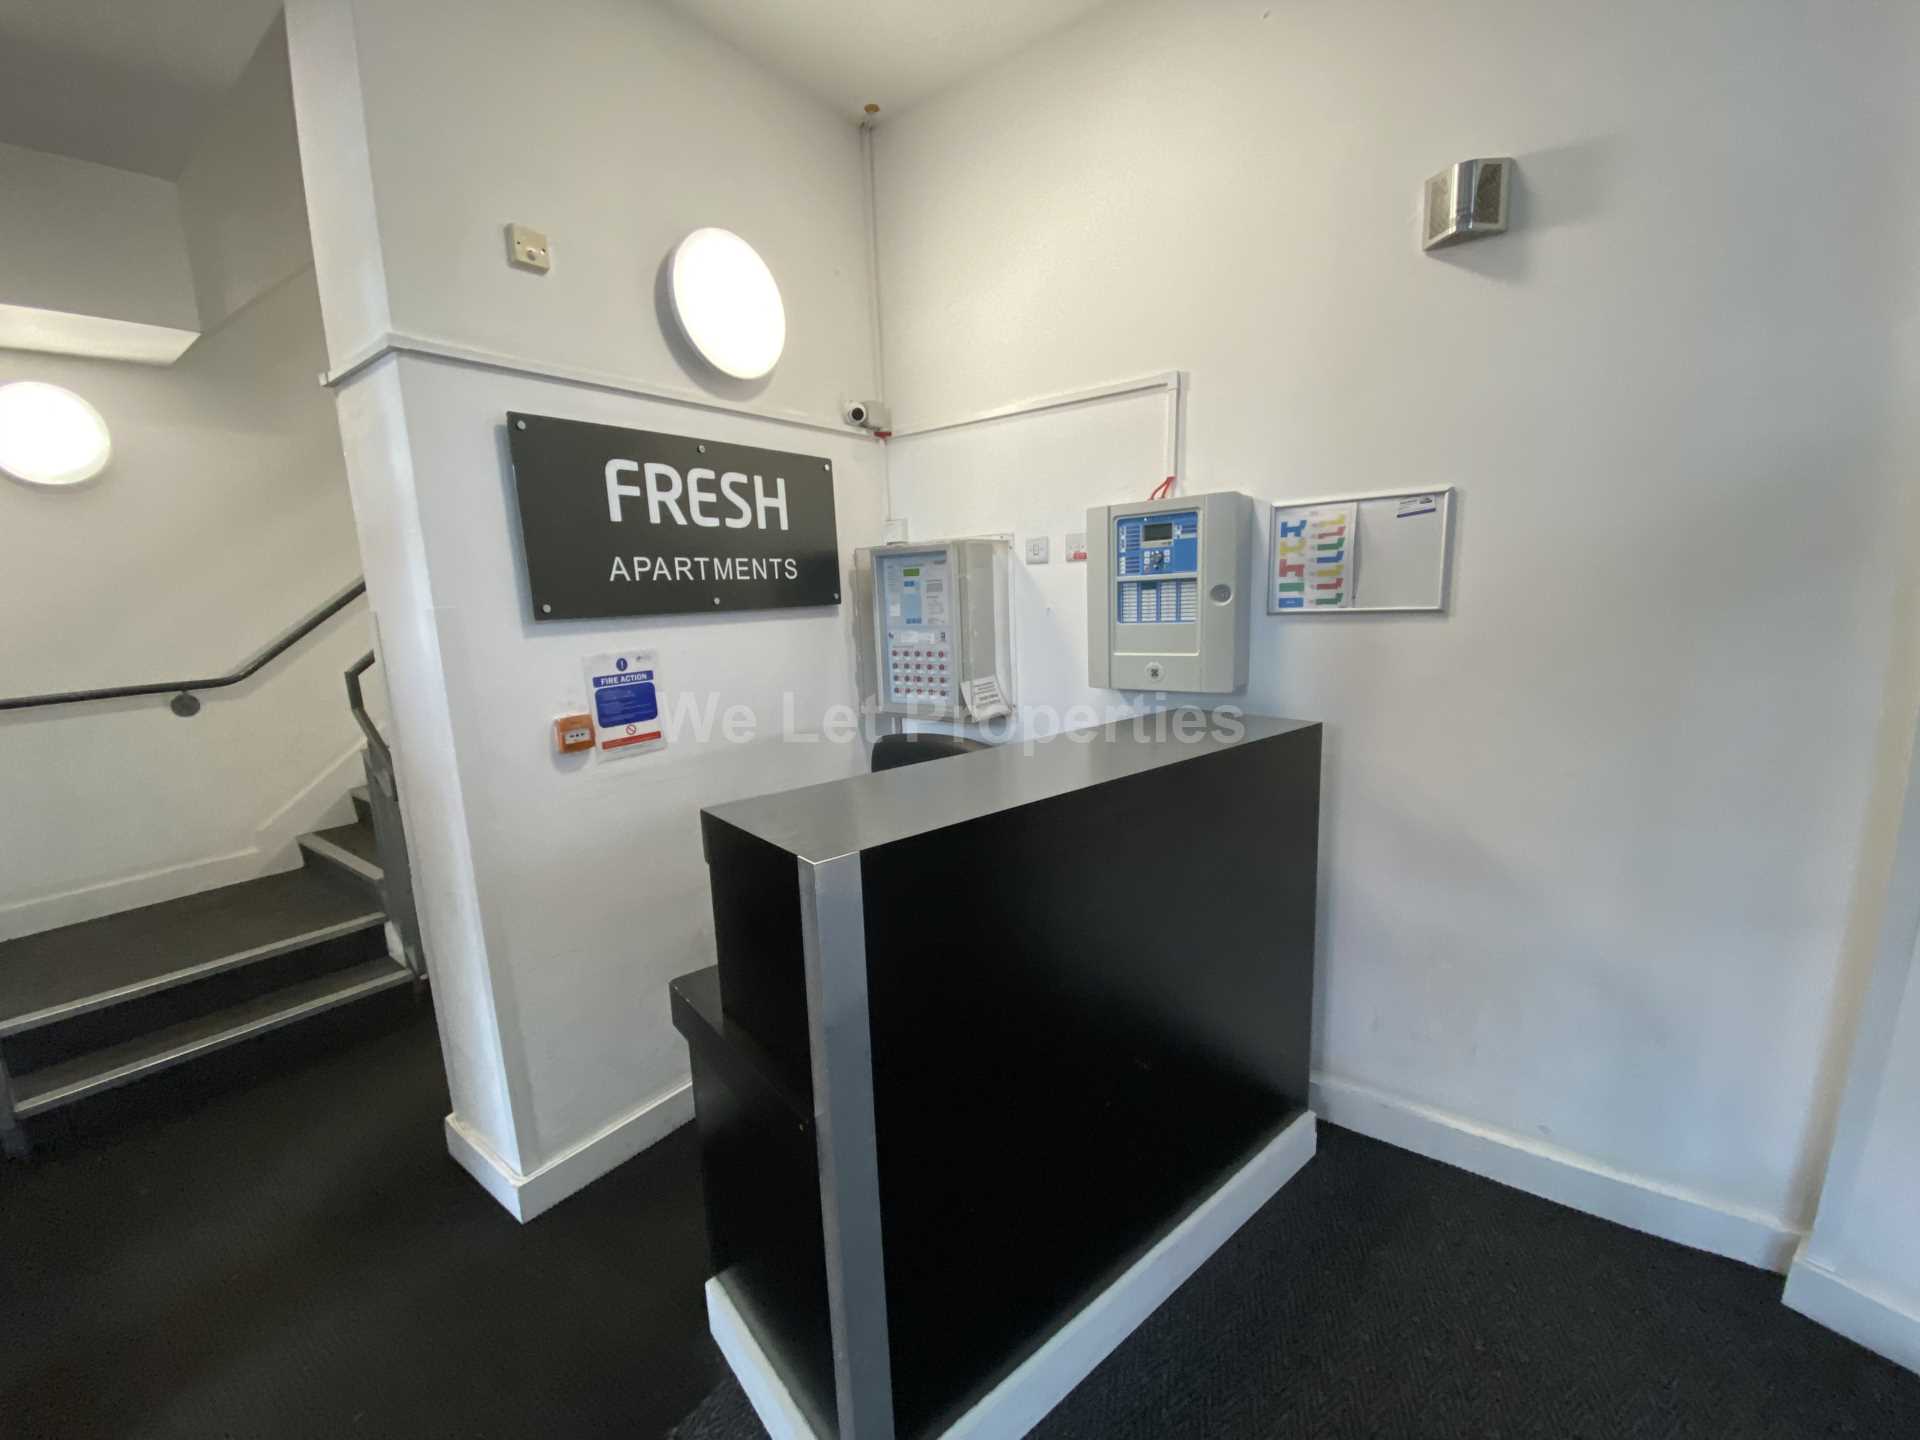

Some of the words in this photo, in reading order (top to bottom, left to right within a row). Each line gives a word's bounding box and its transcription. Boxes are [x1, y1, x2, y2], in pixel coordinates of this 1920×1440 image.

[604, 458, 789, 531] FRESH
[609, 556, 798, 582] APARTMENTS
[601, 676, 619, 685] FIRE
[620, 673, 647, 683] ACTION
